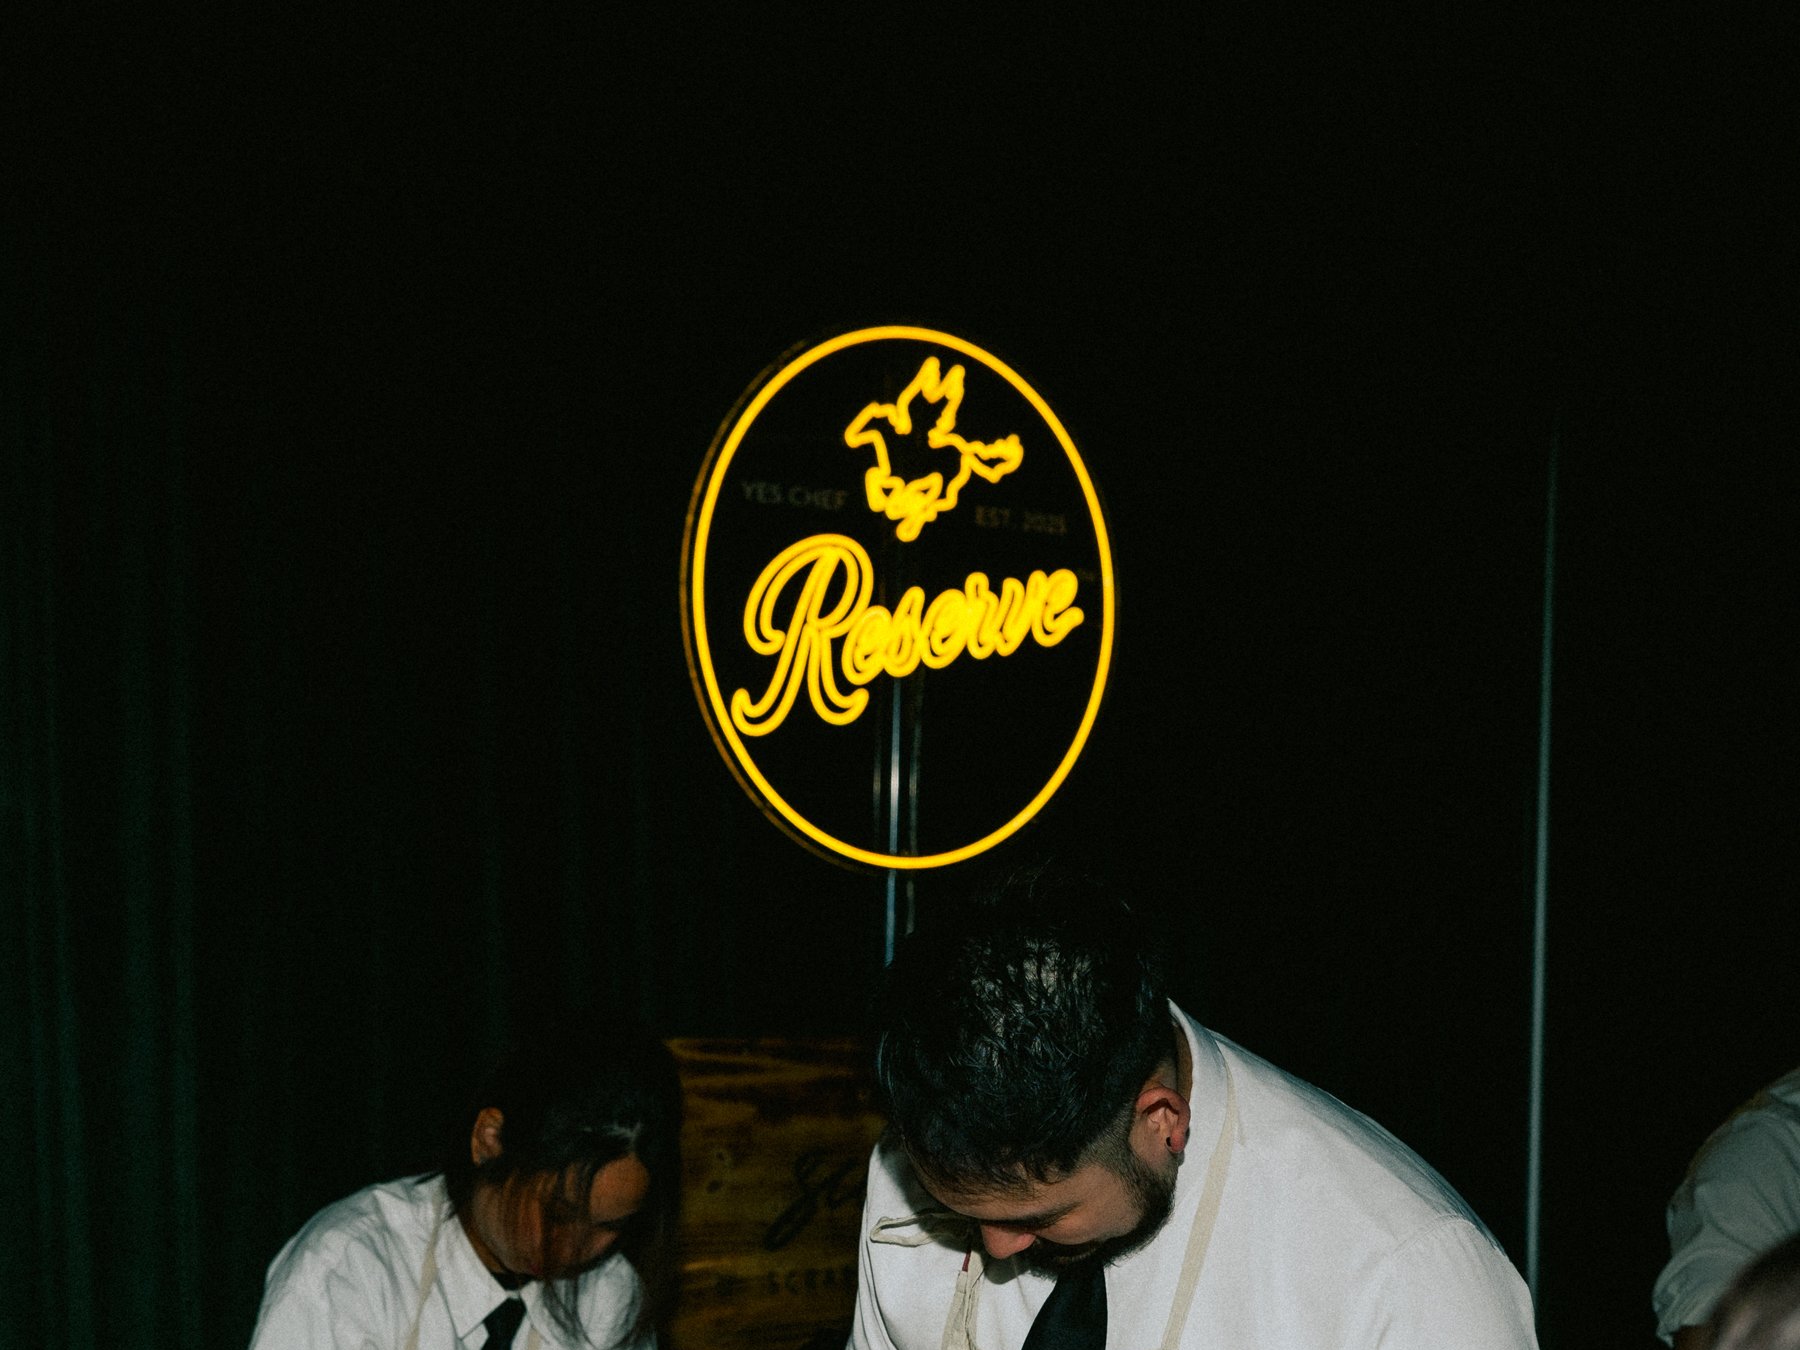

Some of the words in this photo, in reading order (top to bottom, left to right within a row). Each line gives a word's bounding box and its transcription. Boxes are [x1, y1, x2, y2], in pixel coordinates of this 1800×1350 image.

[740, 480, 783, 504] YES
[788, 484, 849, 511] CHEF
[731, 533, 1084, 737] Reserve
